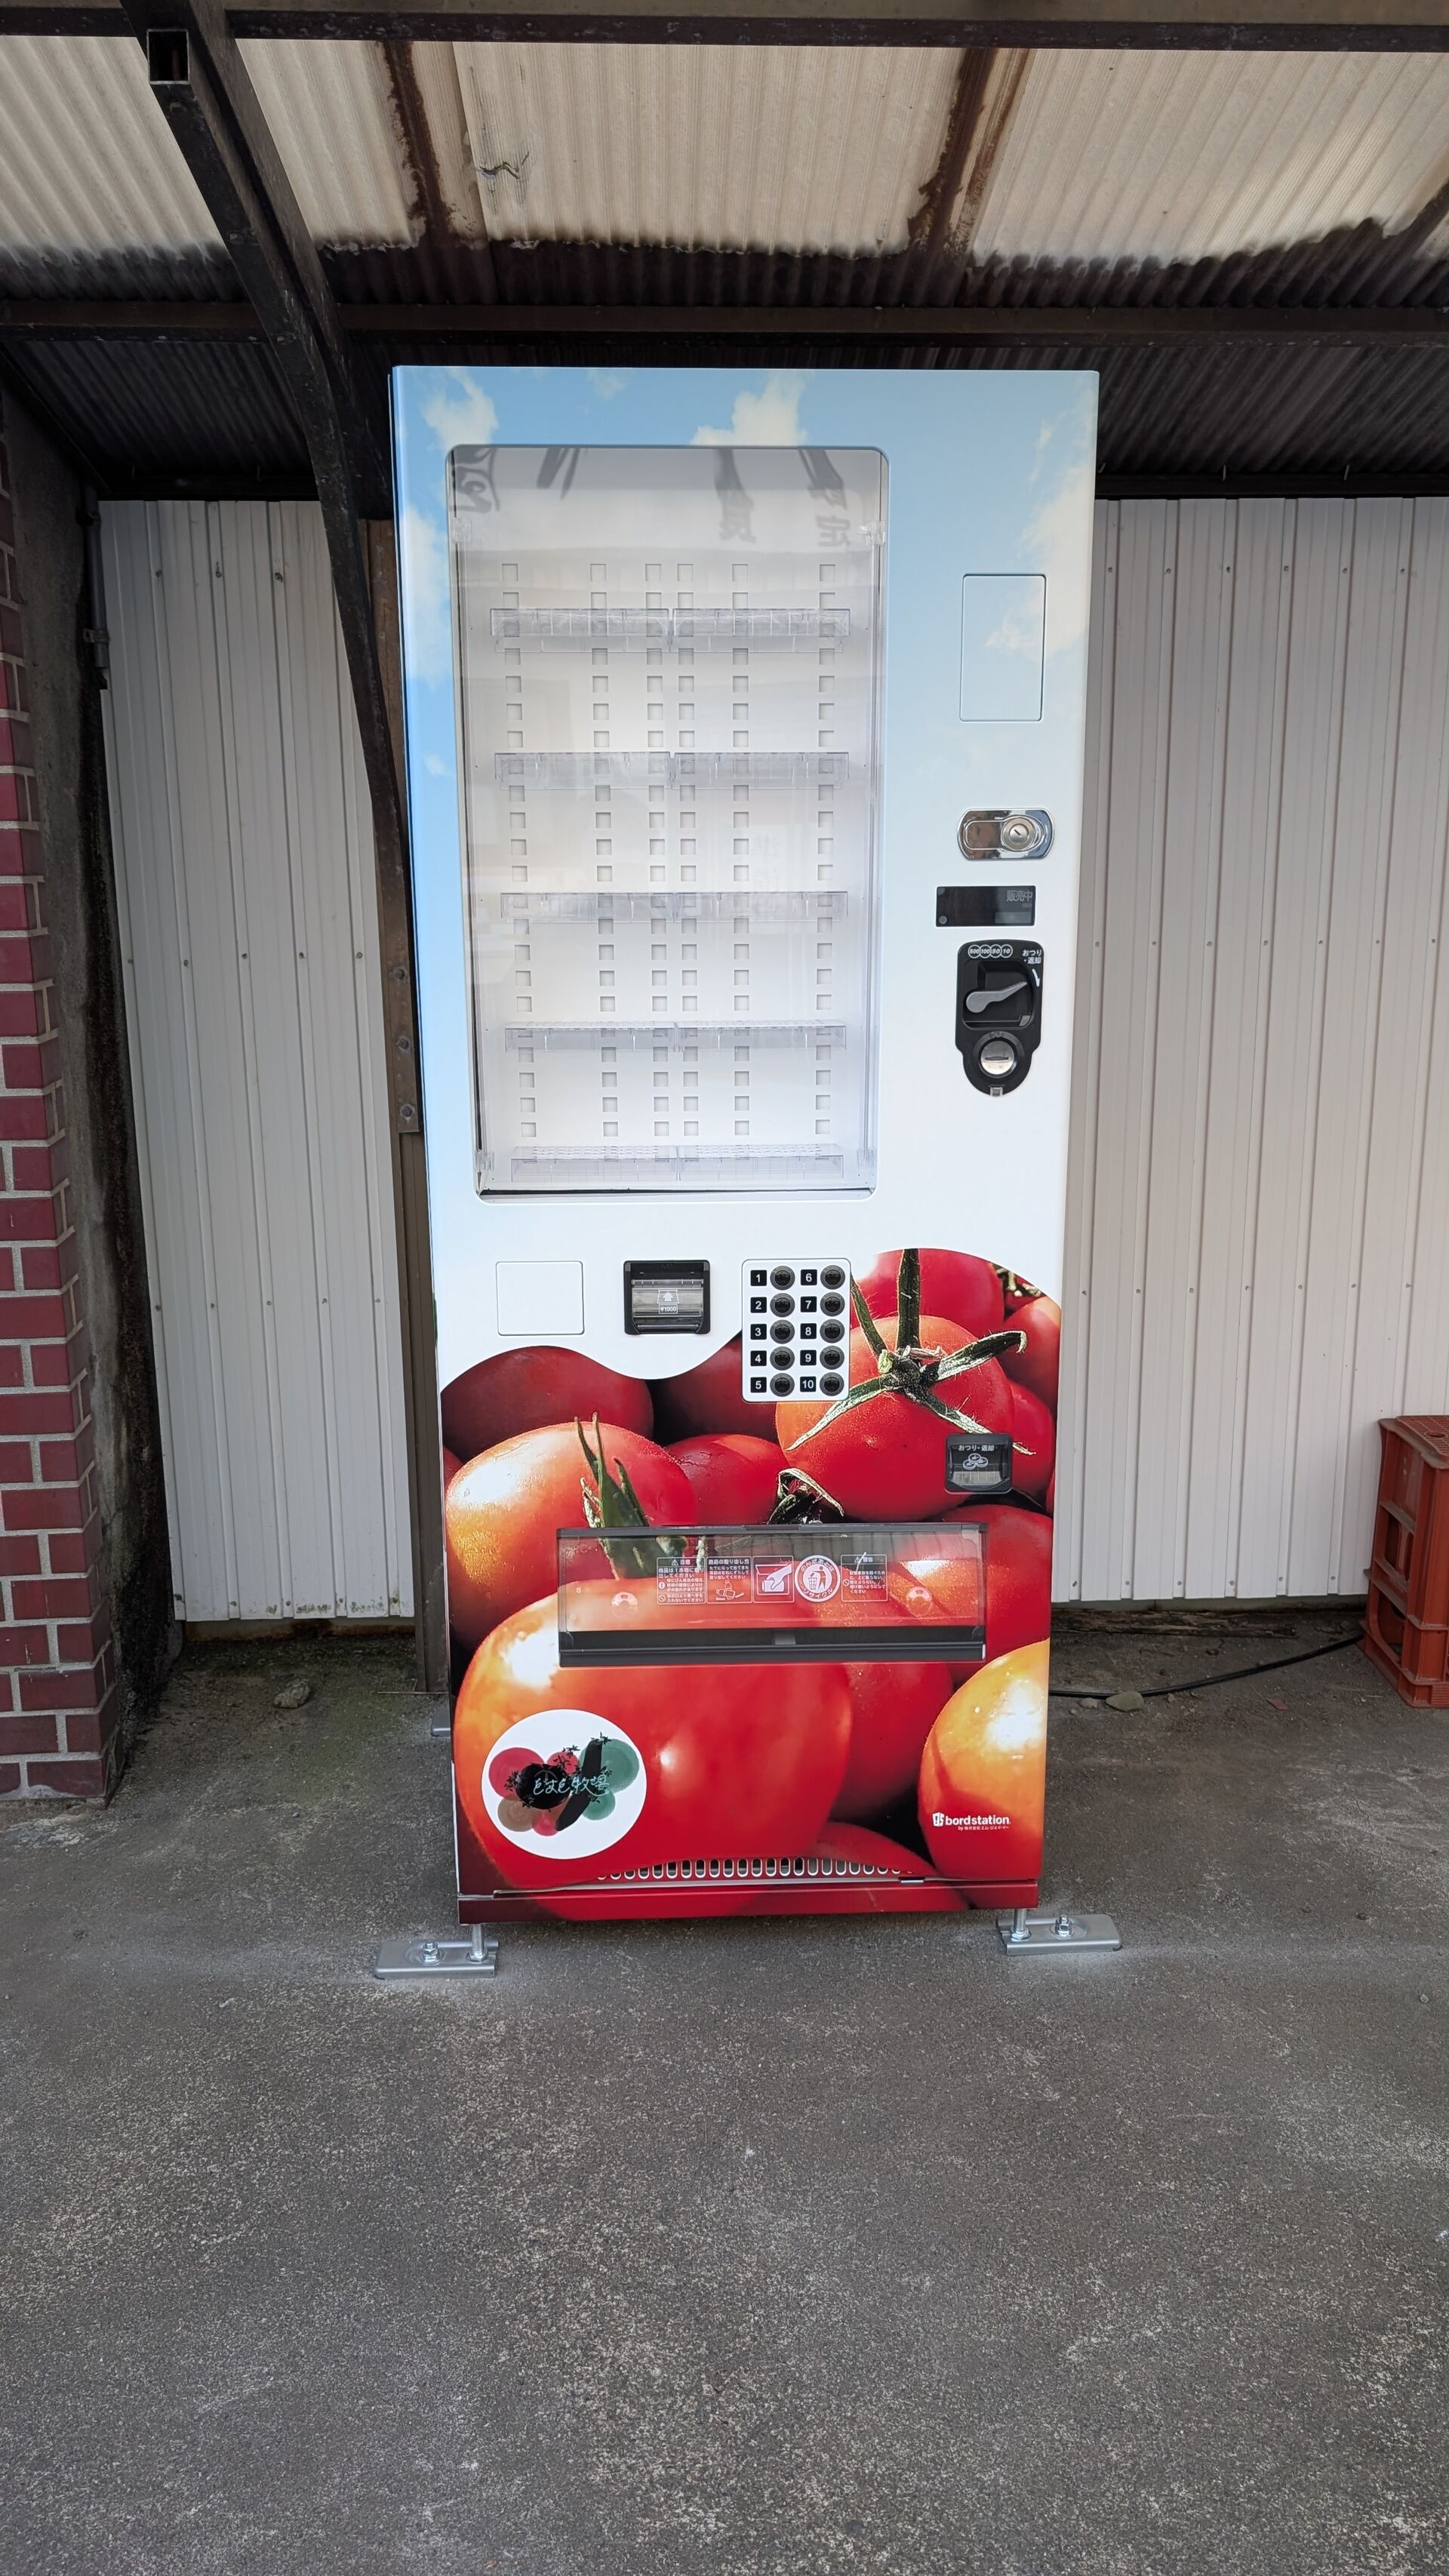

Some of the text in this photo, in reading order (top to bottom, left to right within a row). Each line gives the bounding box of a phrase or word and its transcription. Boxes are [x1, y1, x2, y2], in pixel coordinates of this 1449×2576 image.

[1007, 890, 1032, 902] 販売中
[805, 1273, 812, 1282] 6
[755, 1300, 811, 1310] 2 7
[755, 1327, 811, 1336] 3 8
[755, 1353, 811, 1363] 4 9
[755, 1380, 814, 1389] 5 10
[801, 1559, 835, 1572] のんだあとは
[946, 1815, 1010, 1826] bordstation
